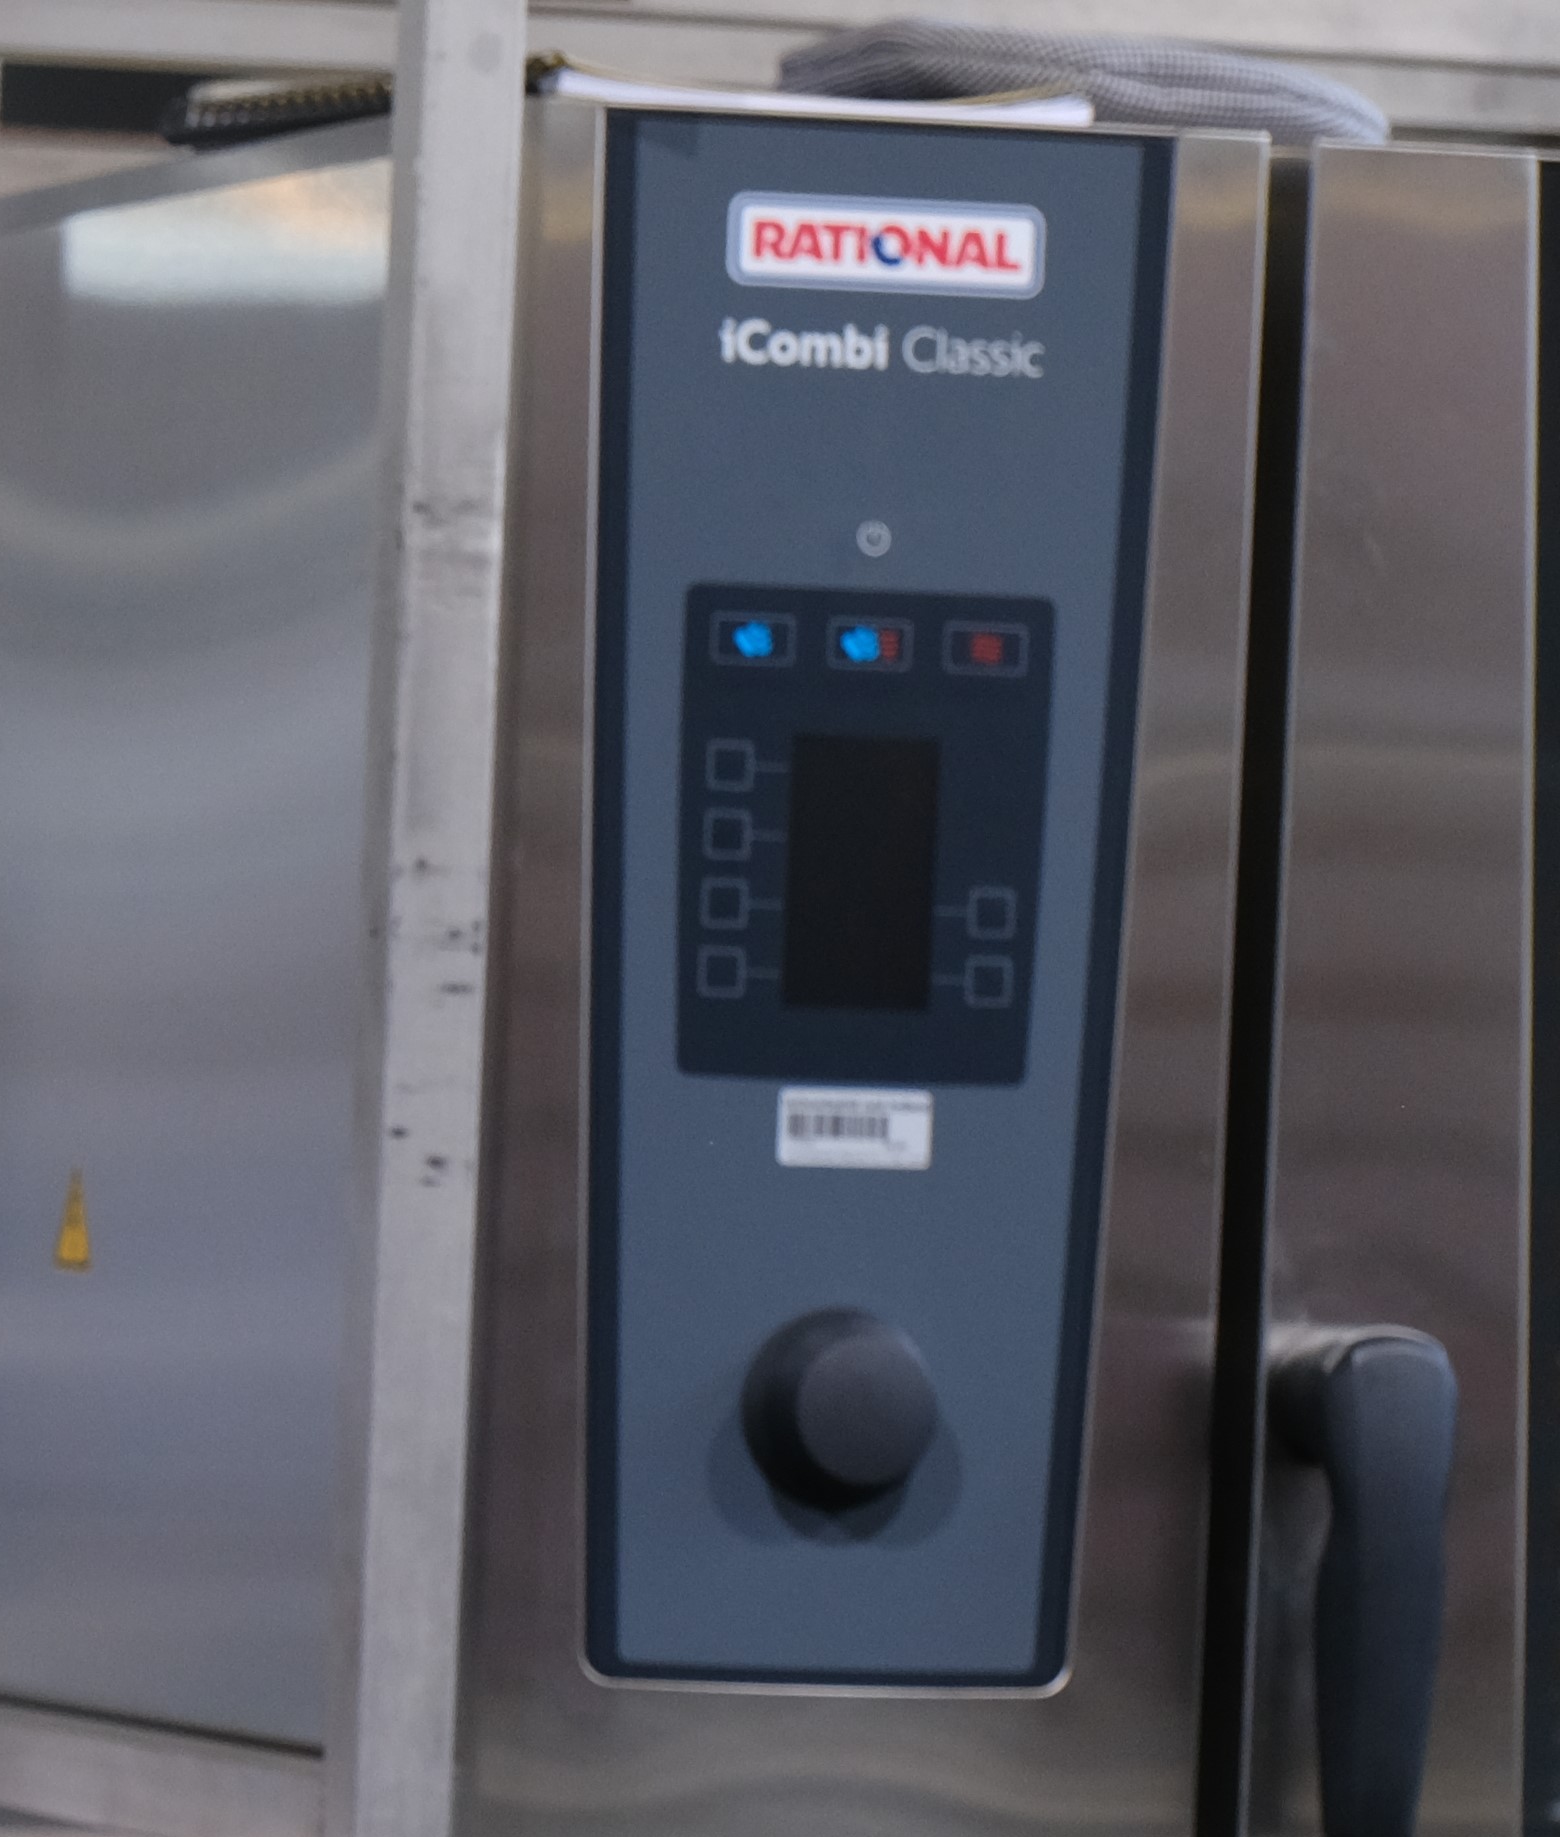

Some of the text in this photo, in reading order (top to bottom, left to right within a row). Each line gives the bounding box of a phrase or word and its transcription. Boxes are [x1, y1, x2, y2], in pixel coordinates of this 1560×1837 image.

[753, 221, 1020, 270] RATIONAL
[719, 317, 1046, 378] iCombi Classic
